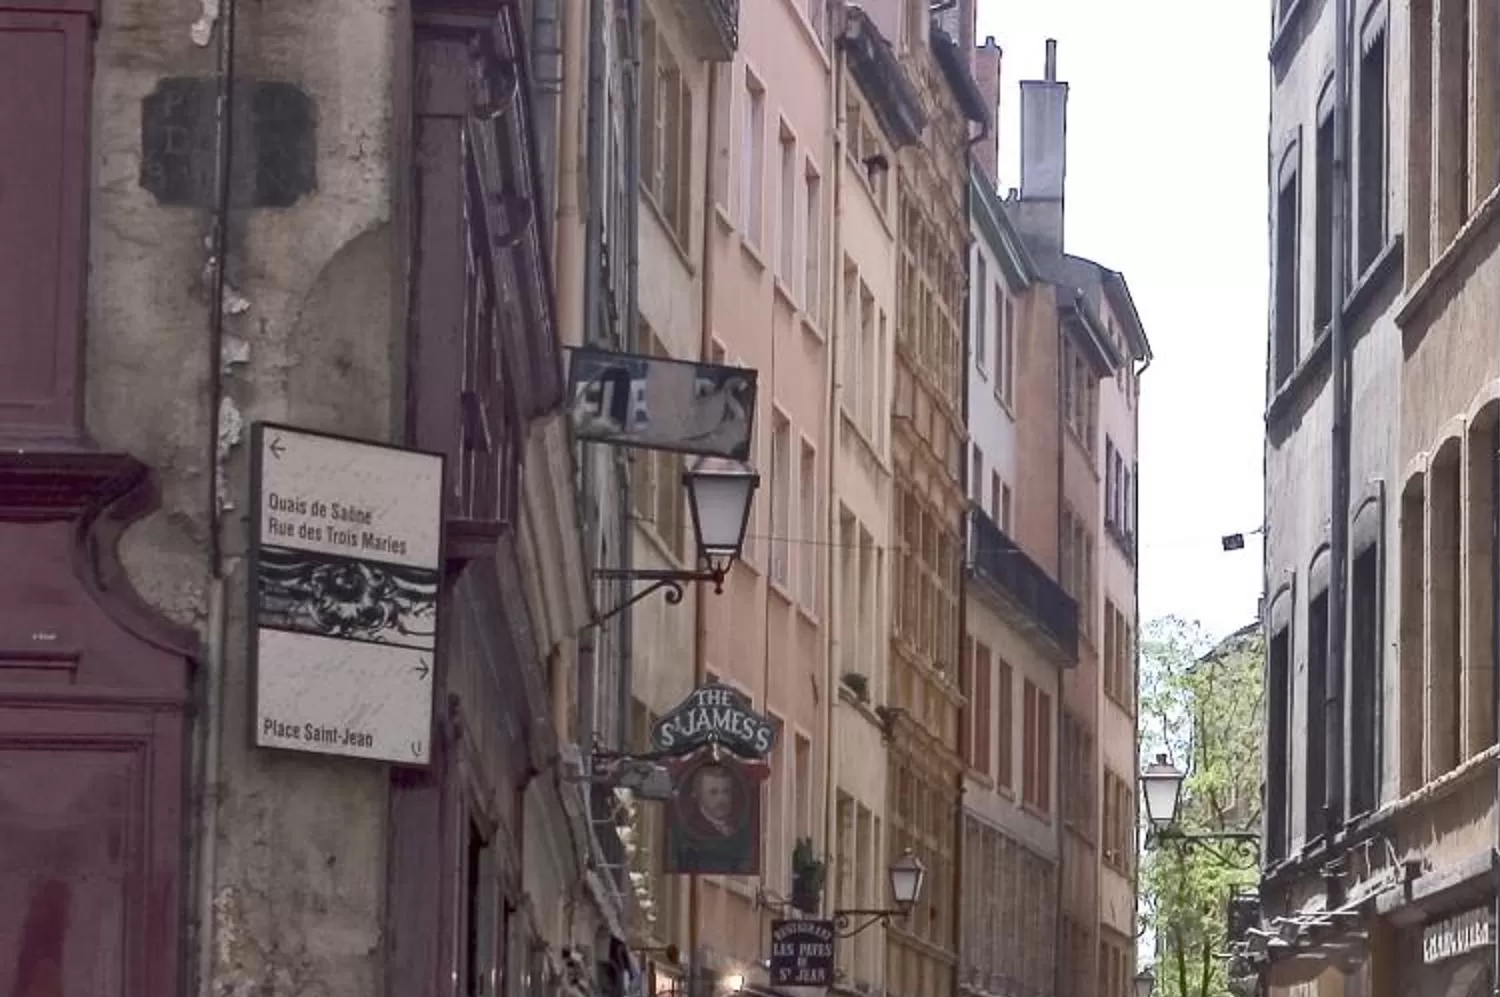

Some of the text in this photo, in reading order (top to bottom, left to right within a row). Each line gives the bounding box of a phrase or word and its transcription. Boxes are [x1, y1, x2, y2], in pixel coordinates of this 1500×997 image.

[311, 501, 327, 517] de
[269, 517, 407, 554] Rue des Trois Maries
[694, 689, 733, 706] THE
[263, 718, 373, 747] Place Saint-Jean
